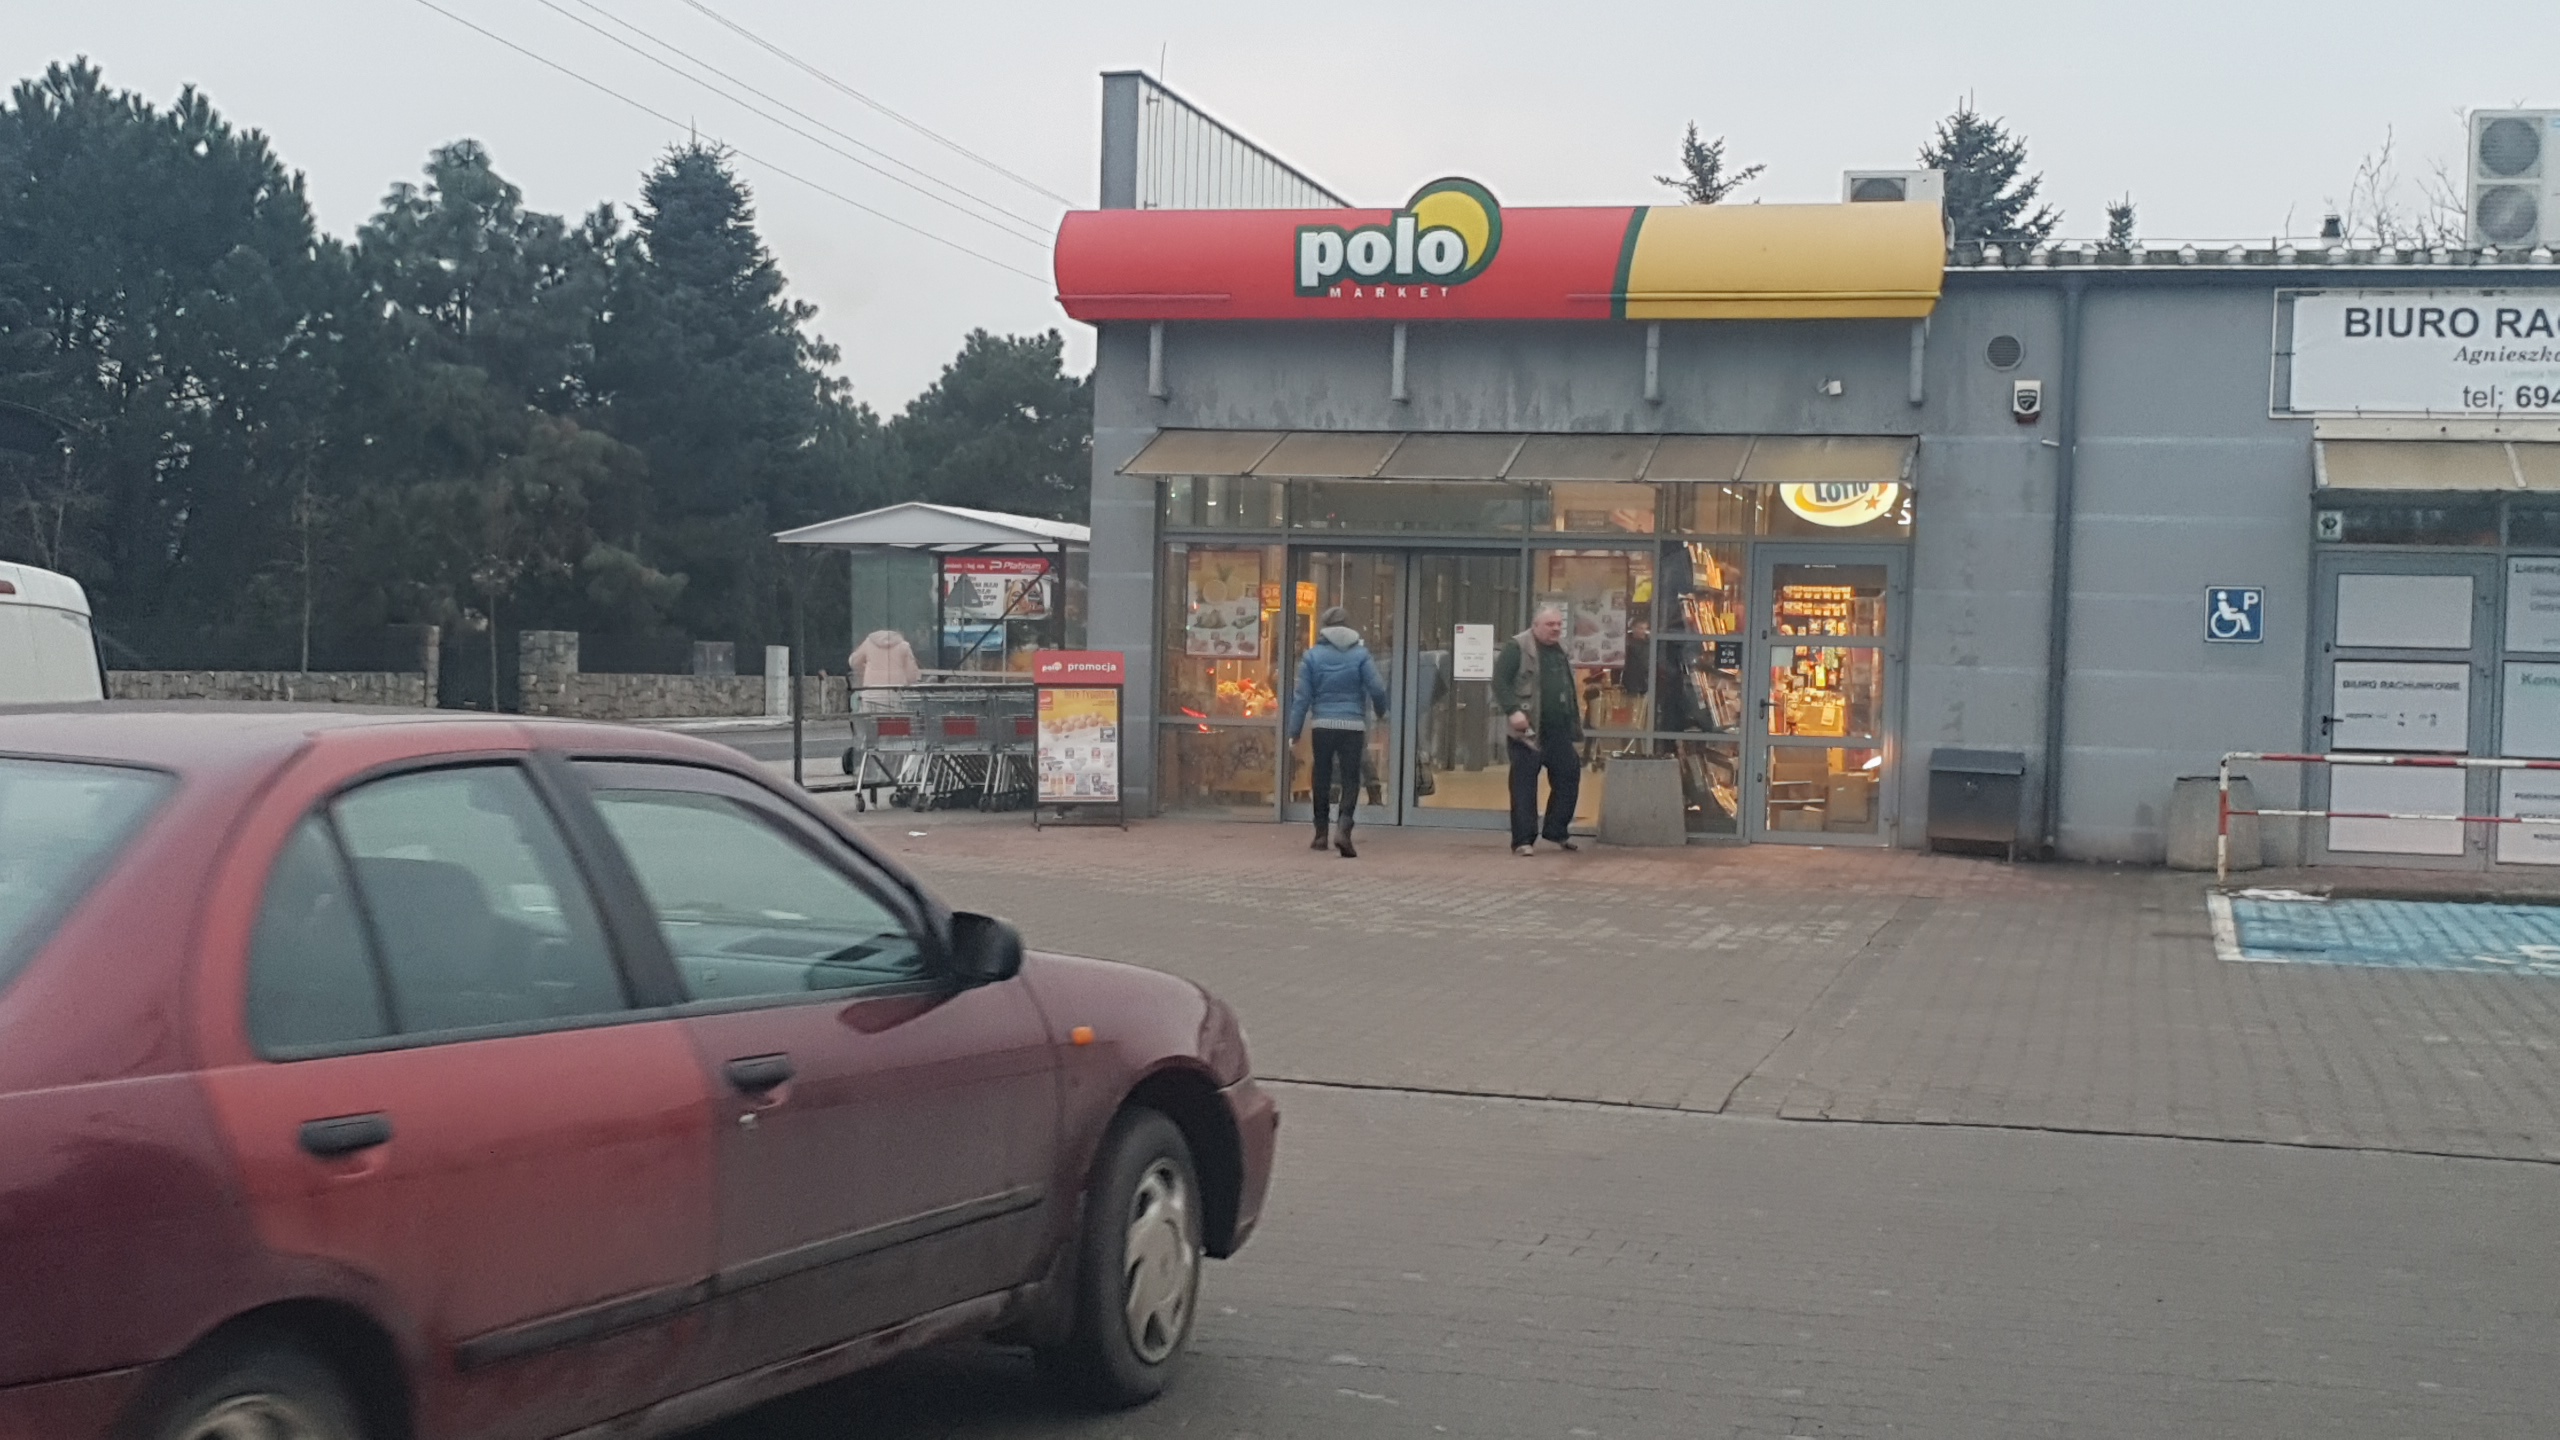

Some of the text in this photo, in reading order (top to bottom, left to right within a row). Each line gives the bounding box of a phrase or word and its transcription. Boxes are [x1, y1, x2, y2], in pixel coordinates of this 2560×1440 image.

[1301, 217, 1463, 287] polo
[1329, 287, 1449, 298] MARKET
[2345, 307, 2560, 339] BIURO RA
[1003, 561, 1041, 570] Platinum
[1067, 662, 1117, 673] promocja
